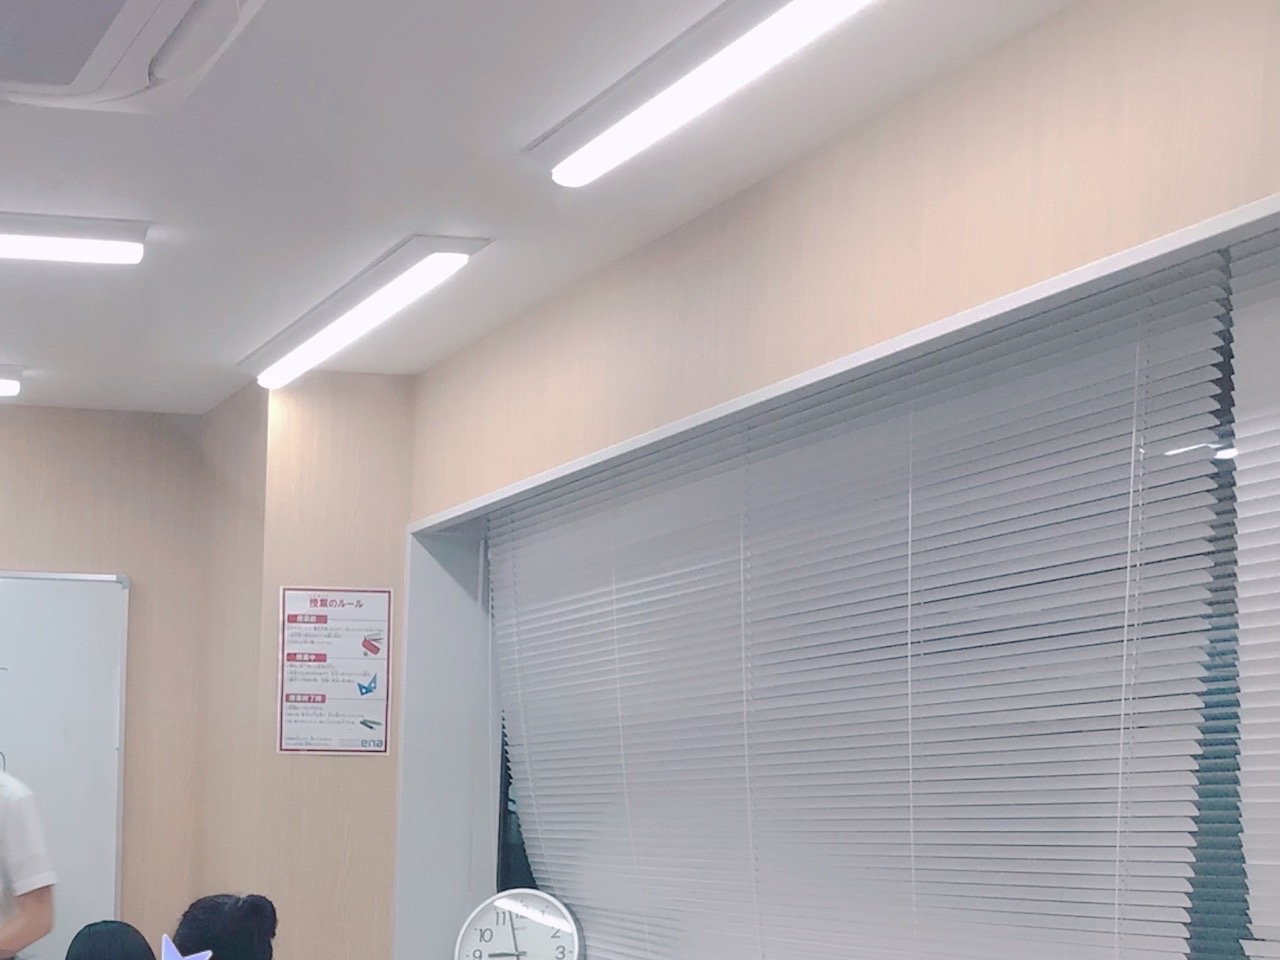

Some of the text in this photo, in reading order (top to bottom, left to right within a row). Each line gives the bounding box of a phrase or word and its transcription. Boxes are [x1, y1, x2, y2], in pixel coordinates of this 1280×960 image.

[361, 739, 383, 748] ena
[495, 911, 506, 926] 11
[479, 928, 493, 943] 10
[555, 945, 566, 960] 3
